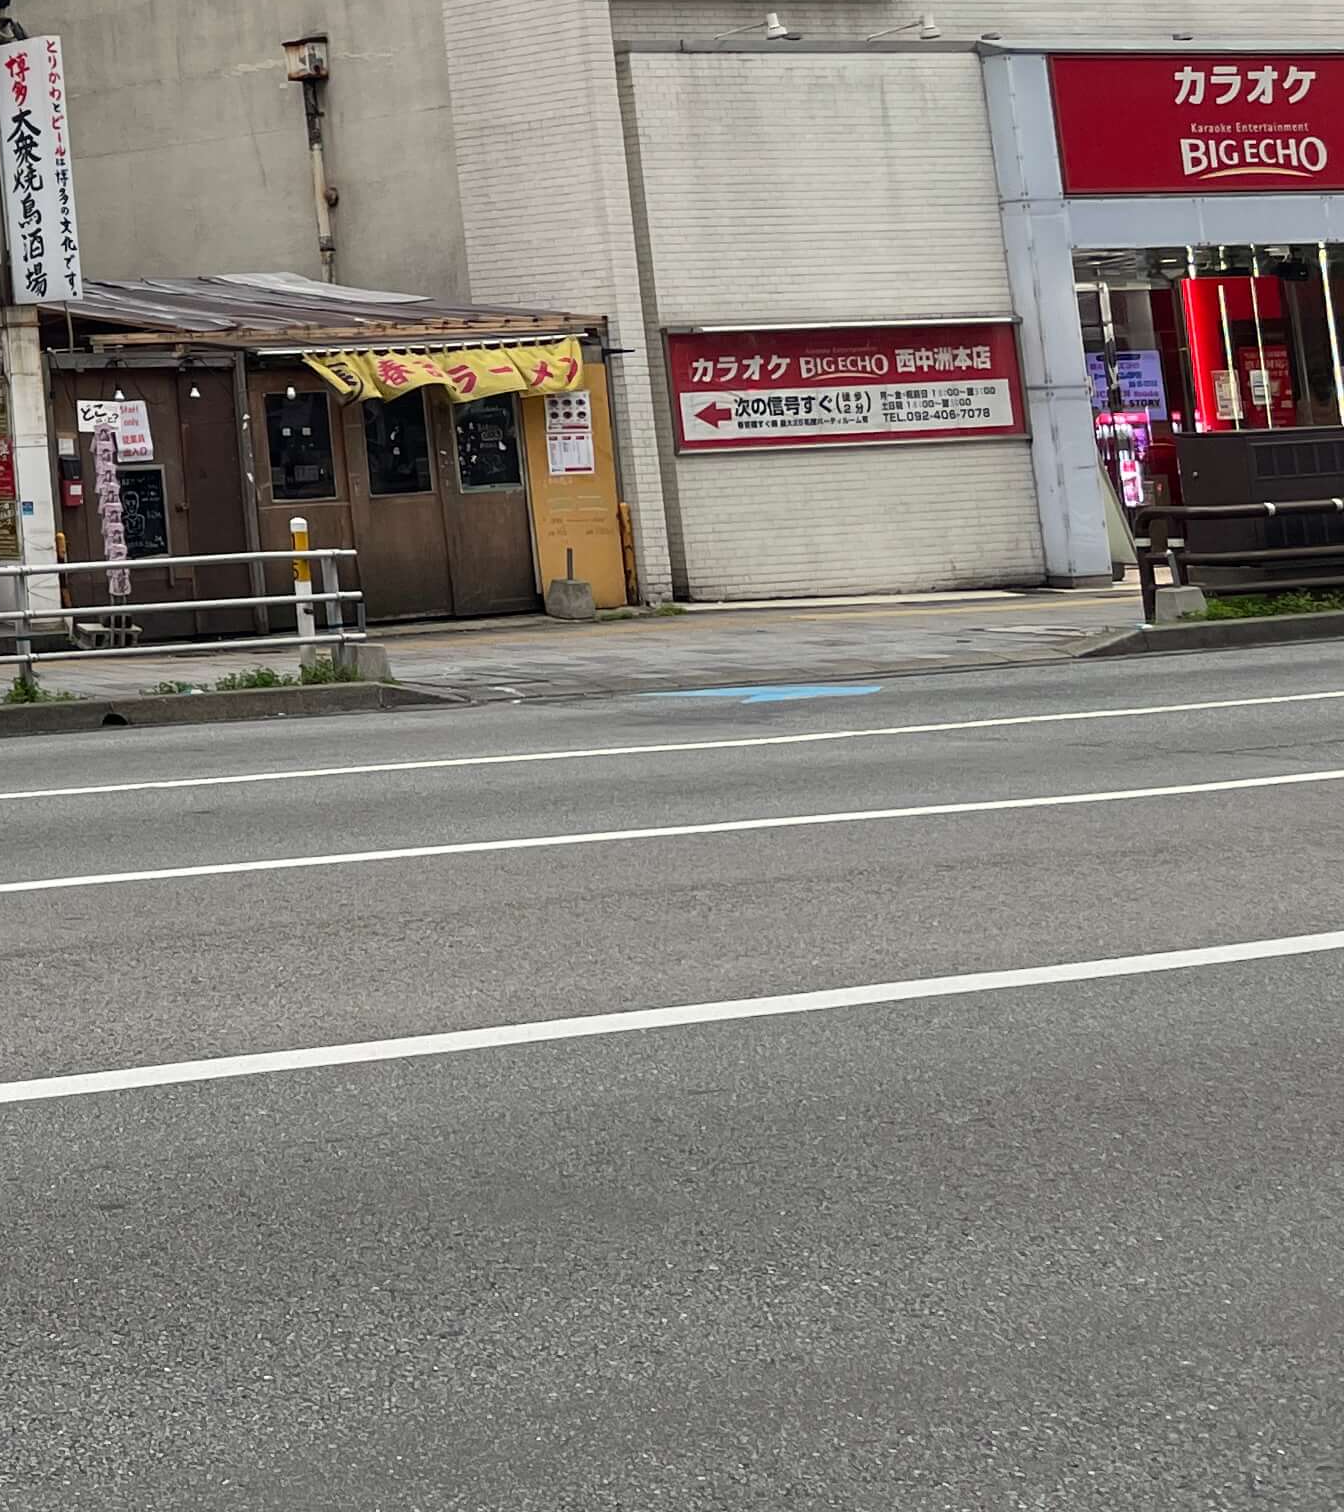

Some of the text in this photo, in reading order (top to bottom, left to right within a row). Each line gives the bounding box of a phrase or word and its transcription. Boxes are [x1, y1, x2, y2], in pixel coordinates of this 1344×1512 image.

[1174, 65, 1317, 105] カラオケ
[1190, 122, 1310, 133] Karaoke Entertainment
[1180, 136, 1328, 176] BIG ECHO
[691, 345, 992, 383] カラオケ BIG ECHO 西中洲本店
